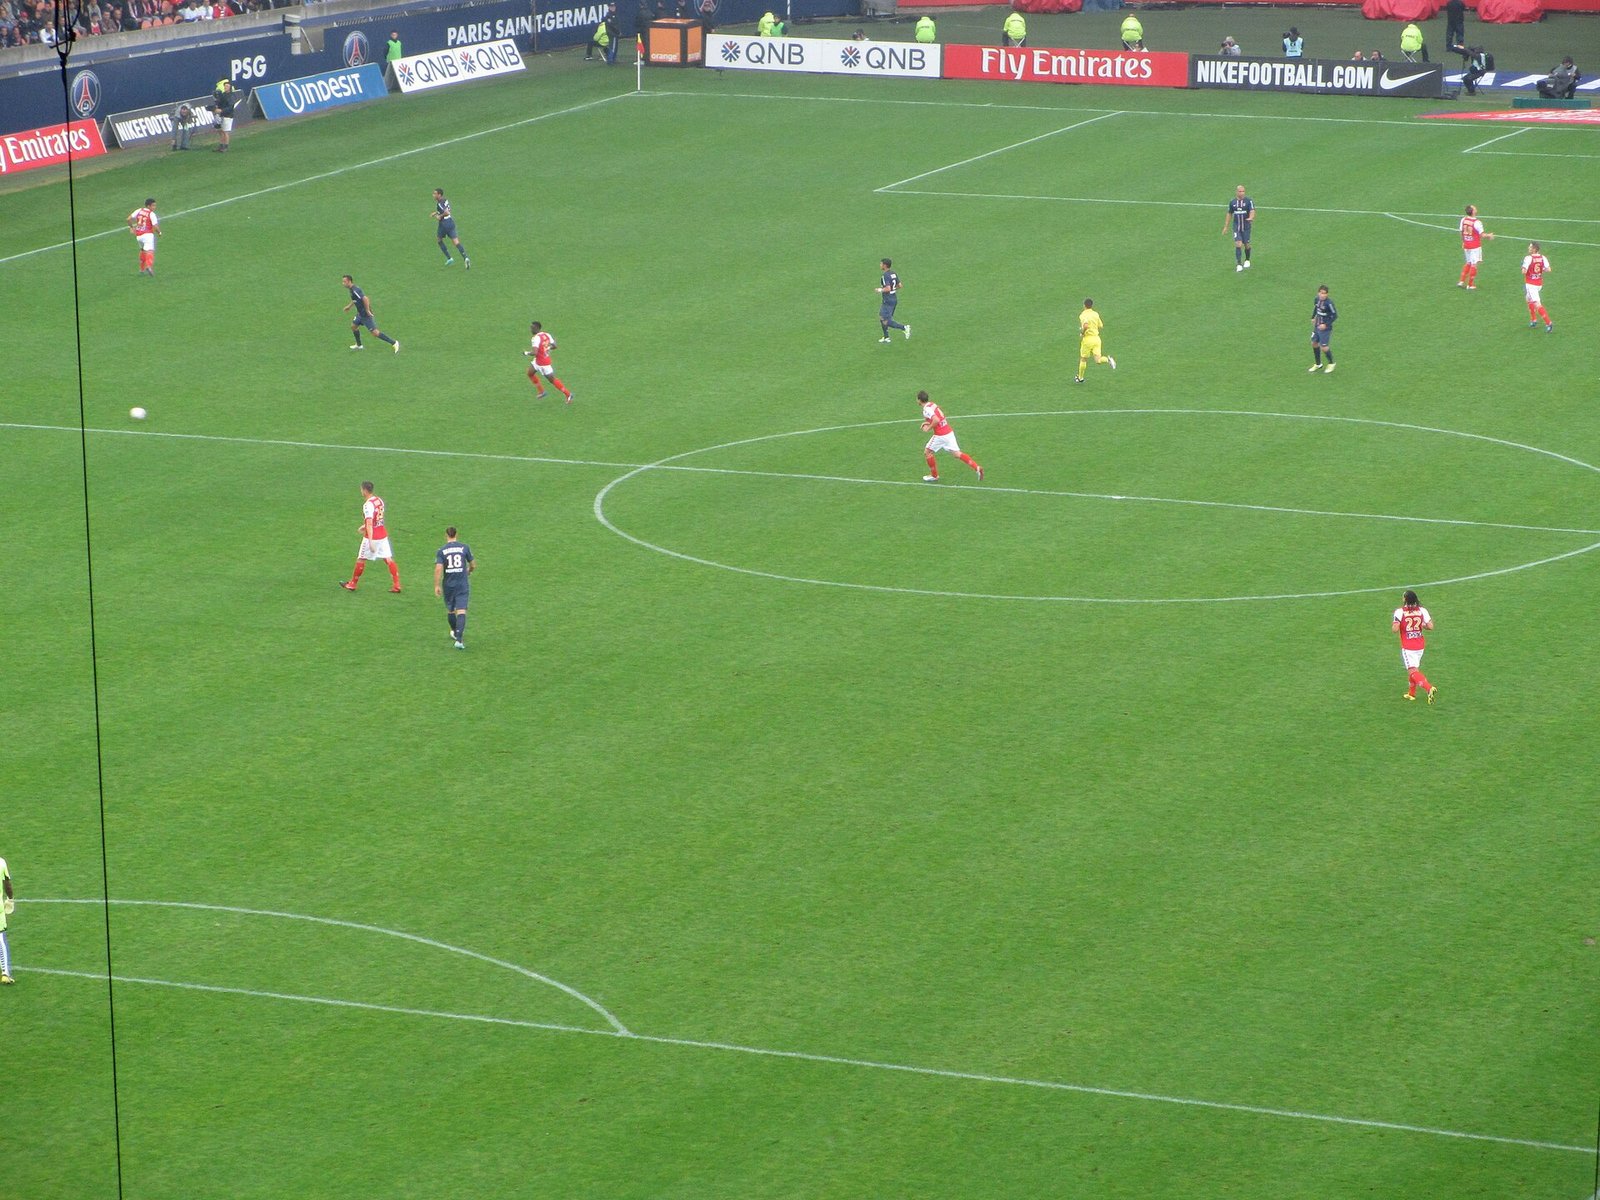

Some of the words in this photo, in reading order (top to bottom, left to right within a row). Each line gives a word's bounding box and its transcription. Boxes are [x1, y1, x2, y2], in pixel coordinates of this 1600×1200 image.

[447, 21, 491, 46] PARIS
[476, 43, 520, 71] QNB
[651, 53, 677, 61] orange
[745, 41, 804, 65] QNB
[866, 47, 926, 71] QNB
[981, 47, 1026, 80] Fly
[1033, 50, 1152, 79] Emirates
[231, 55, 267, 81] PSG
[415, 54, 459, 83] QNB
[1197, 60, 1374, 89] NIKEFOOTBALL.COM
[4, 128, 90, 164] Emirates
[446, 554, 462, 568] 18
[1405, 617, 1421, 631] 22
